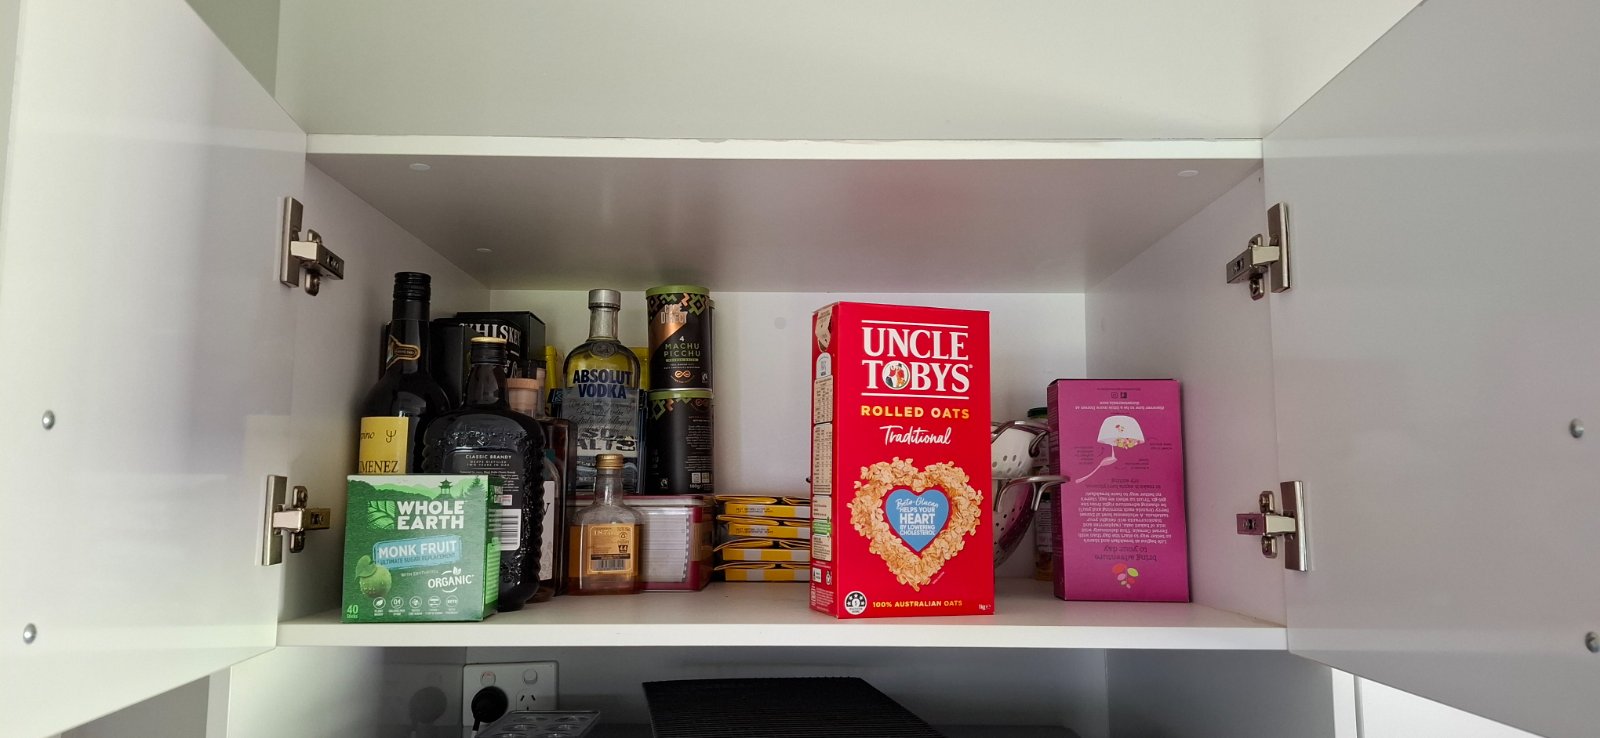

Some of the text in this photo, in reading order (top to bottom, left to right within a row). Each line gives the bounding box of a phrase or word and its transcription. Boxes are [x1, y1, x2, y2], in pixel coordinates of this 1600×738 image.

[862, 326, 968, 360] UNCLE
[573, 368, 632, 385] ABSOLUT
[578, 384, 626, 399] VODKA
[861, 406, 970, 419] ROLLED OATS
[880, 425, 952, 446] Traditional
[397, 500, 464, 515] WHOLE
[397, 516, 464, 530] EARTH
[900, 513, 935, 524] HEART
[378, 540, 457, 558] MONK FRUIT
[428, 574, 472, 588] ORGANIC
[347, 604, 358, 614] 40
